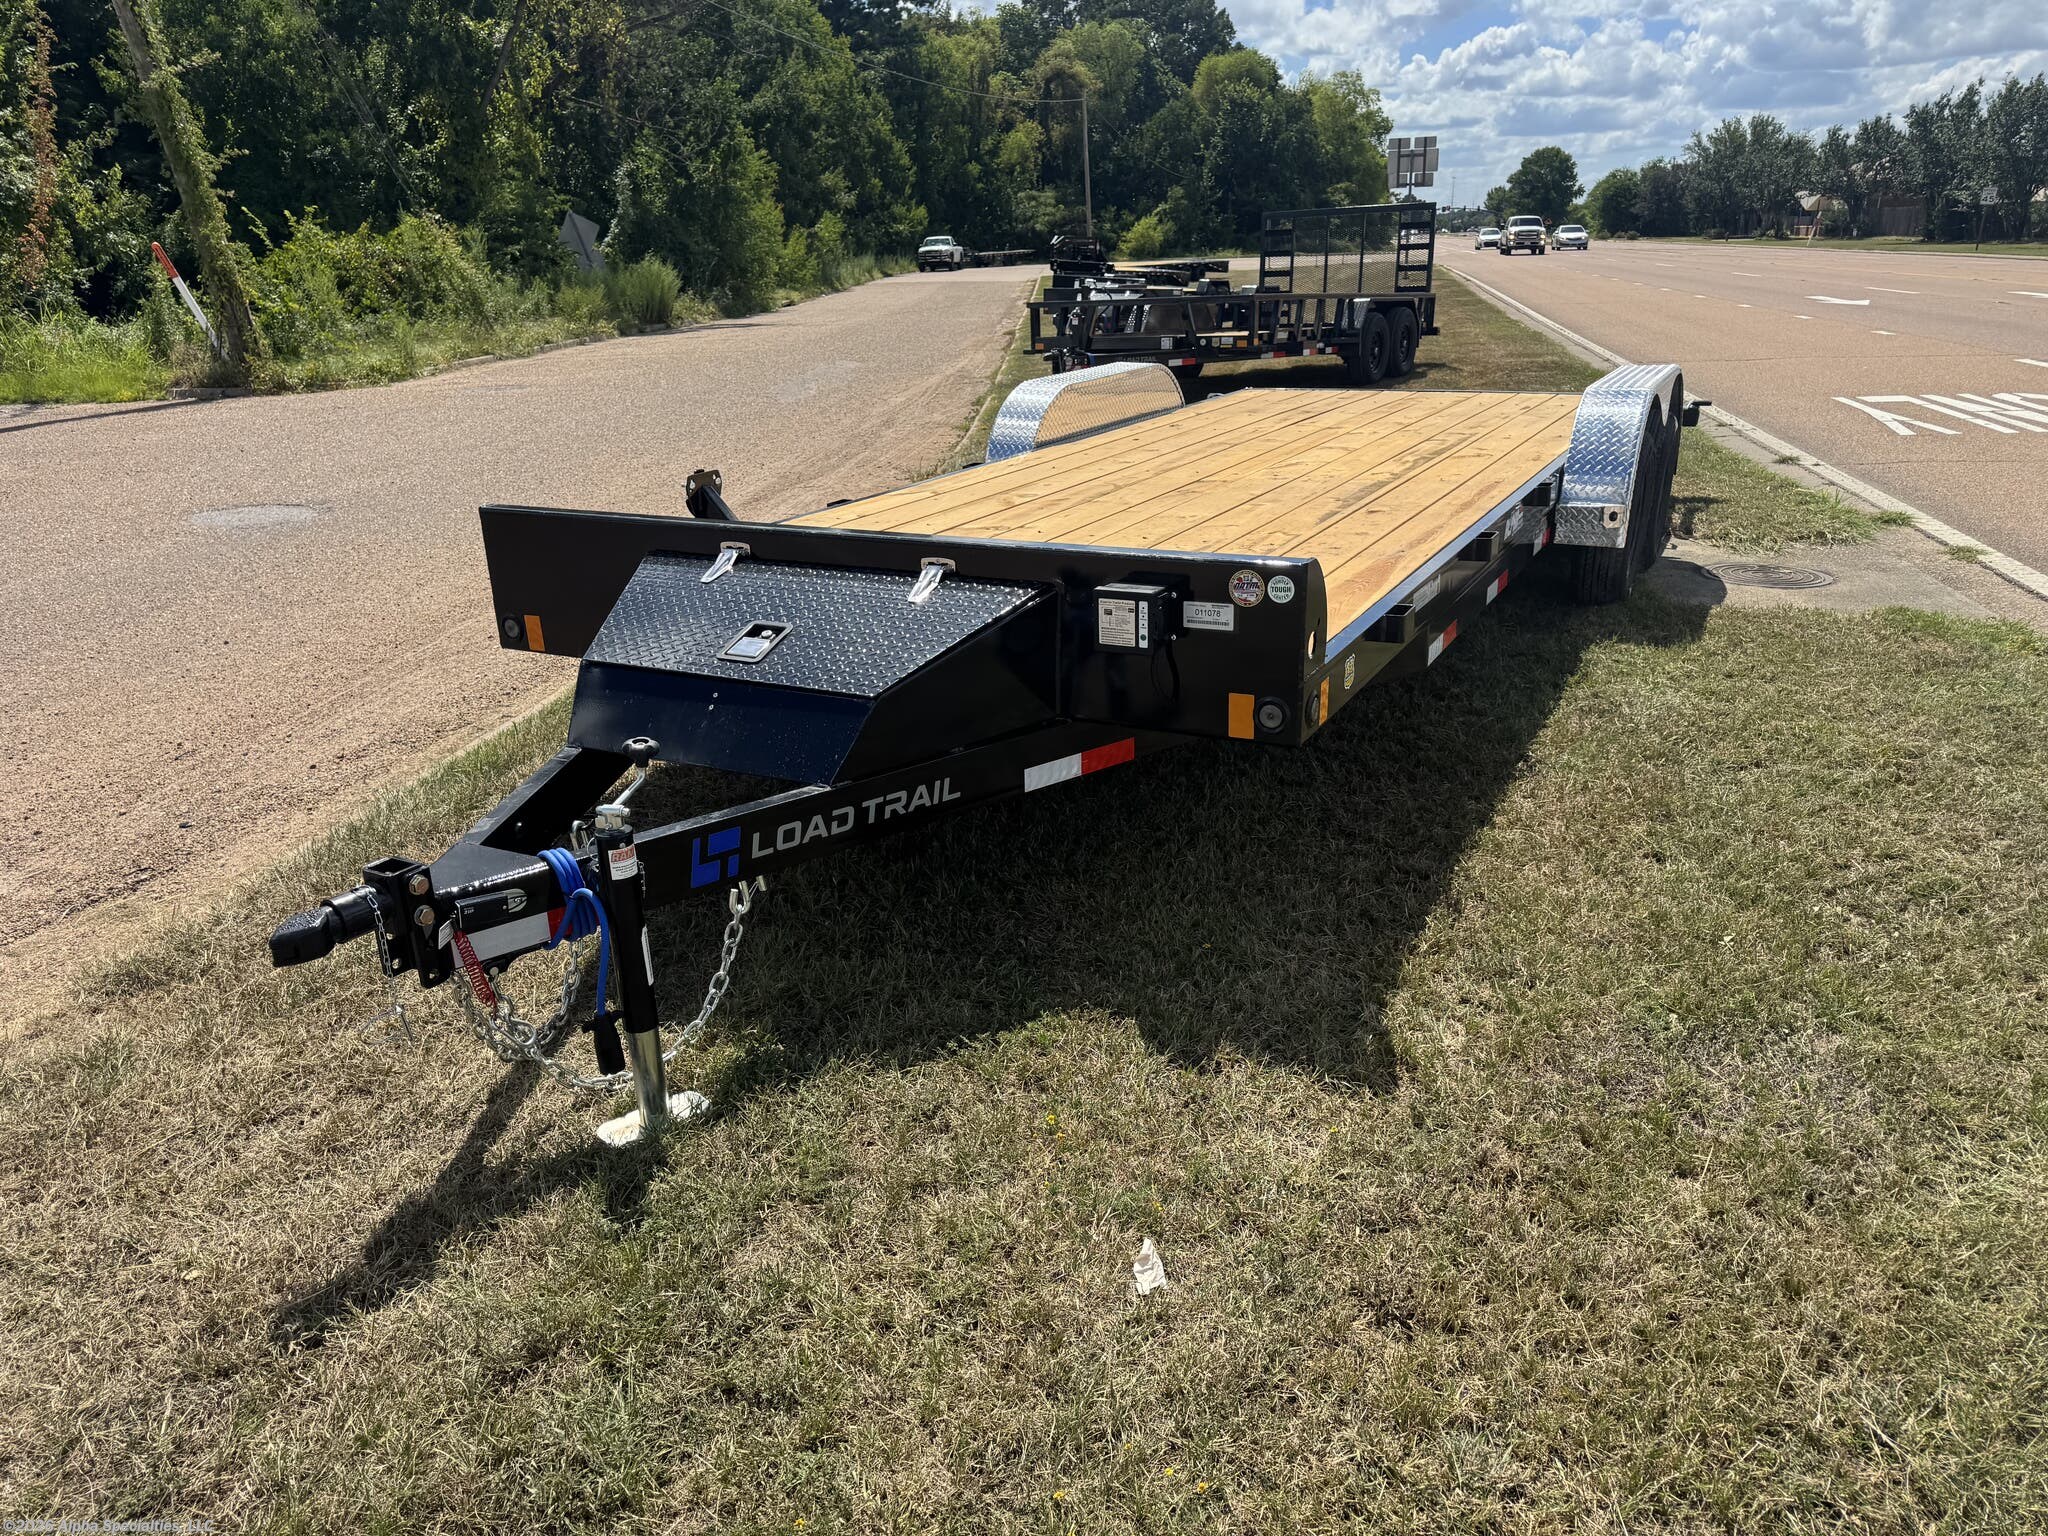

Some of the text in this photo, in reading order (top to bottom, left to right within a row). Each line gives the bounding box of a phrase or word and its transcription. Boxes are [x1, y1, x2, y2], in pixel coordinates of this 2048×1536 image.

[1194, 608, 1221, 617] 011078
[752, 806, 855, 859] LOAD
[862, 777, 961, 824] TRAIL
